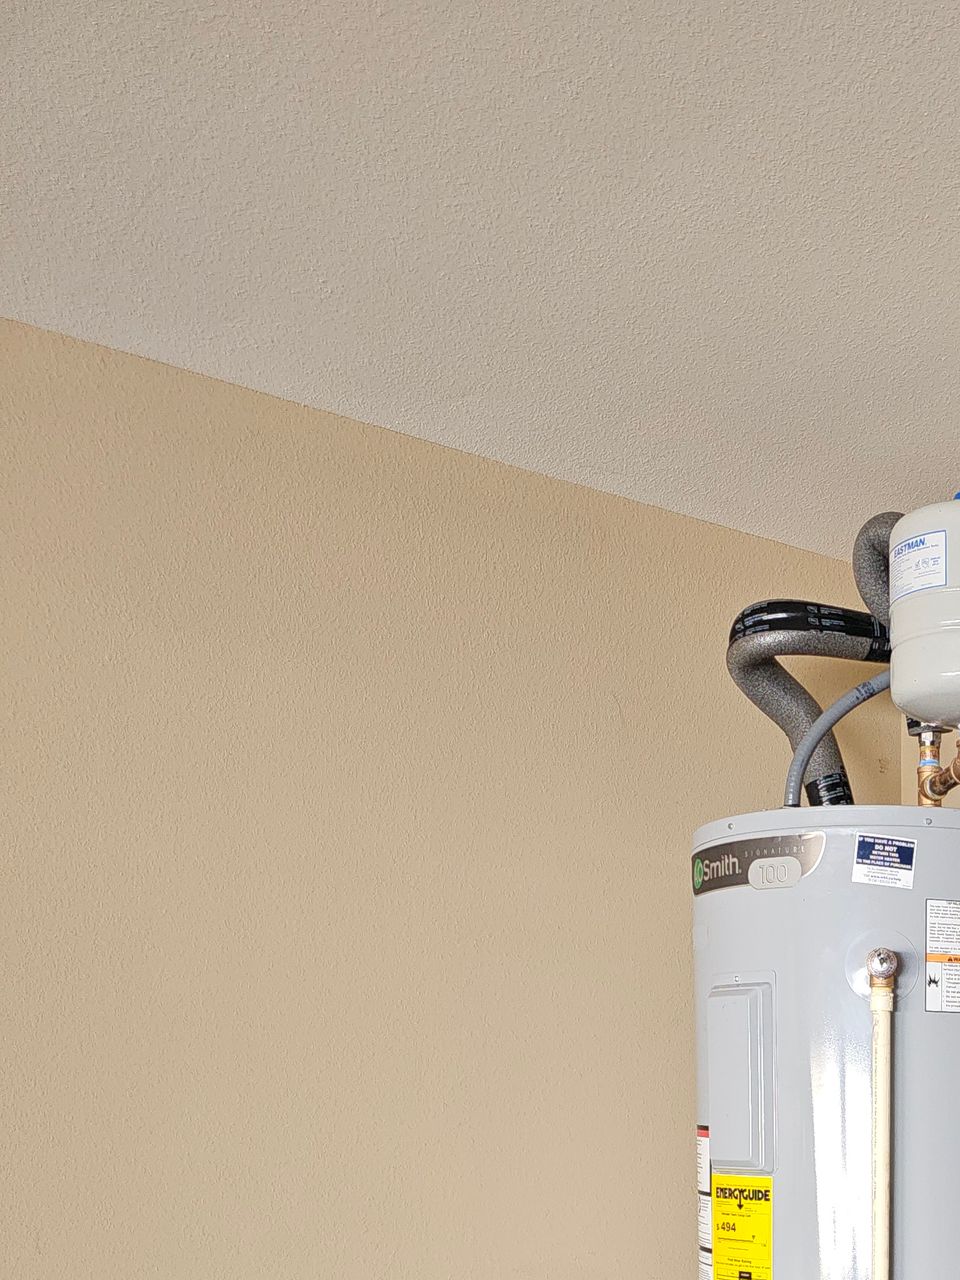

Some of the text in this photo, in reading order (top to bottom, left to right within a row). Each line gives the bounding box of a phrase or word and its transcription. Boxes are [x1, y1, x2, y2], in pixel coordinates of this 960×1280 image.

[894, 537, 925, 559] EASTMAN
[744, 845, 805, 858] SIGNATURE
[703, 854, 739, 881] Smith
[759, 864, 788, 884] 100
[716, 1187, 770, 1202] ENERGYGUIDE
